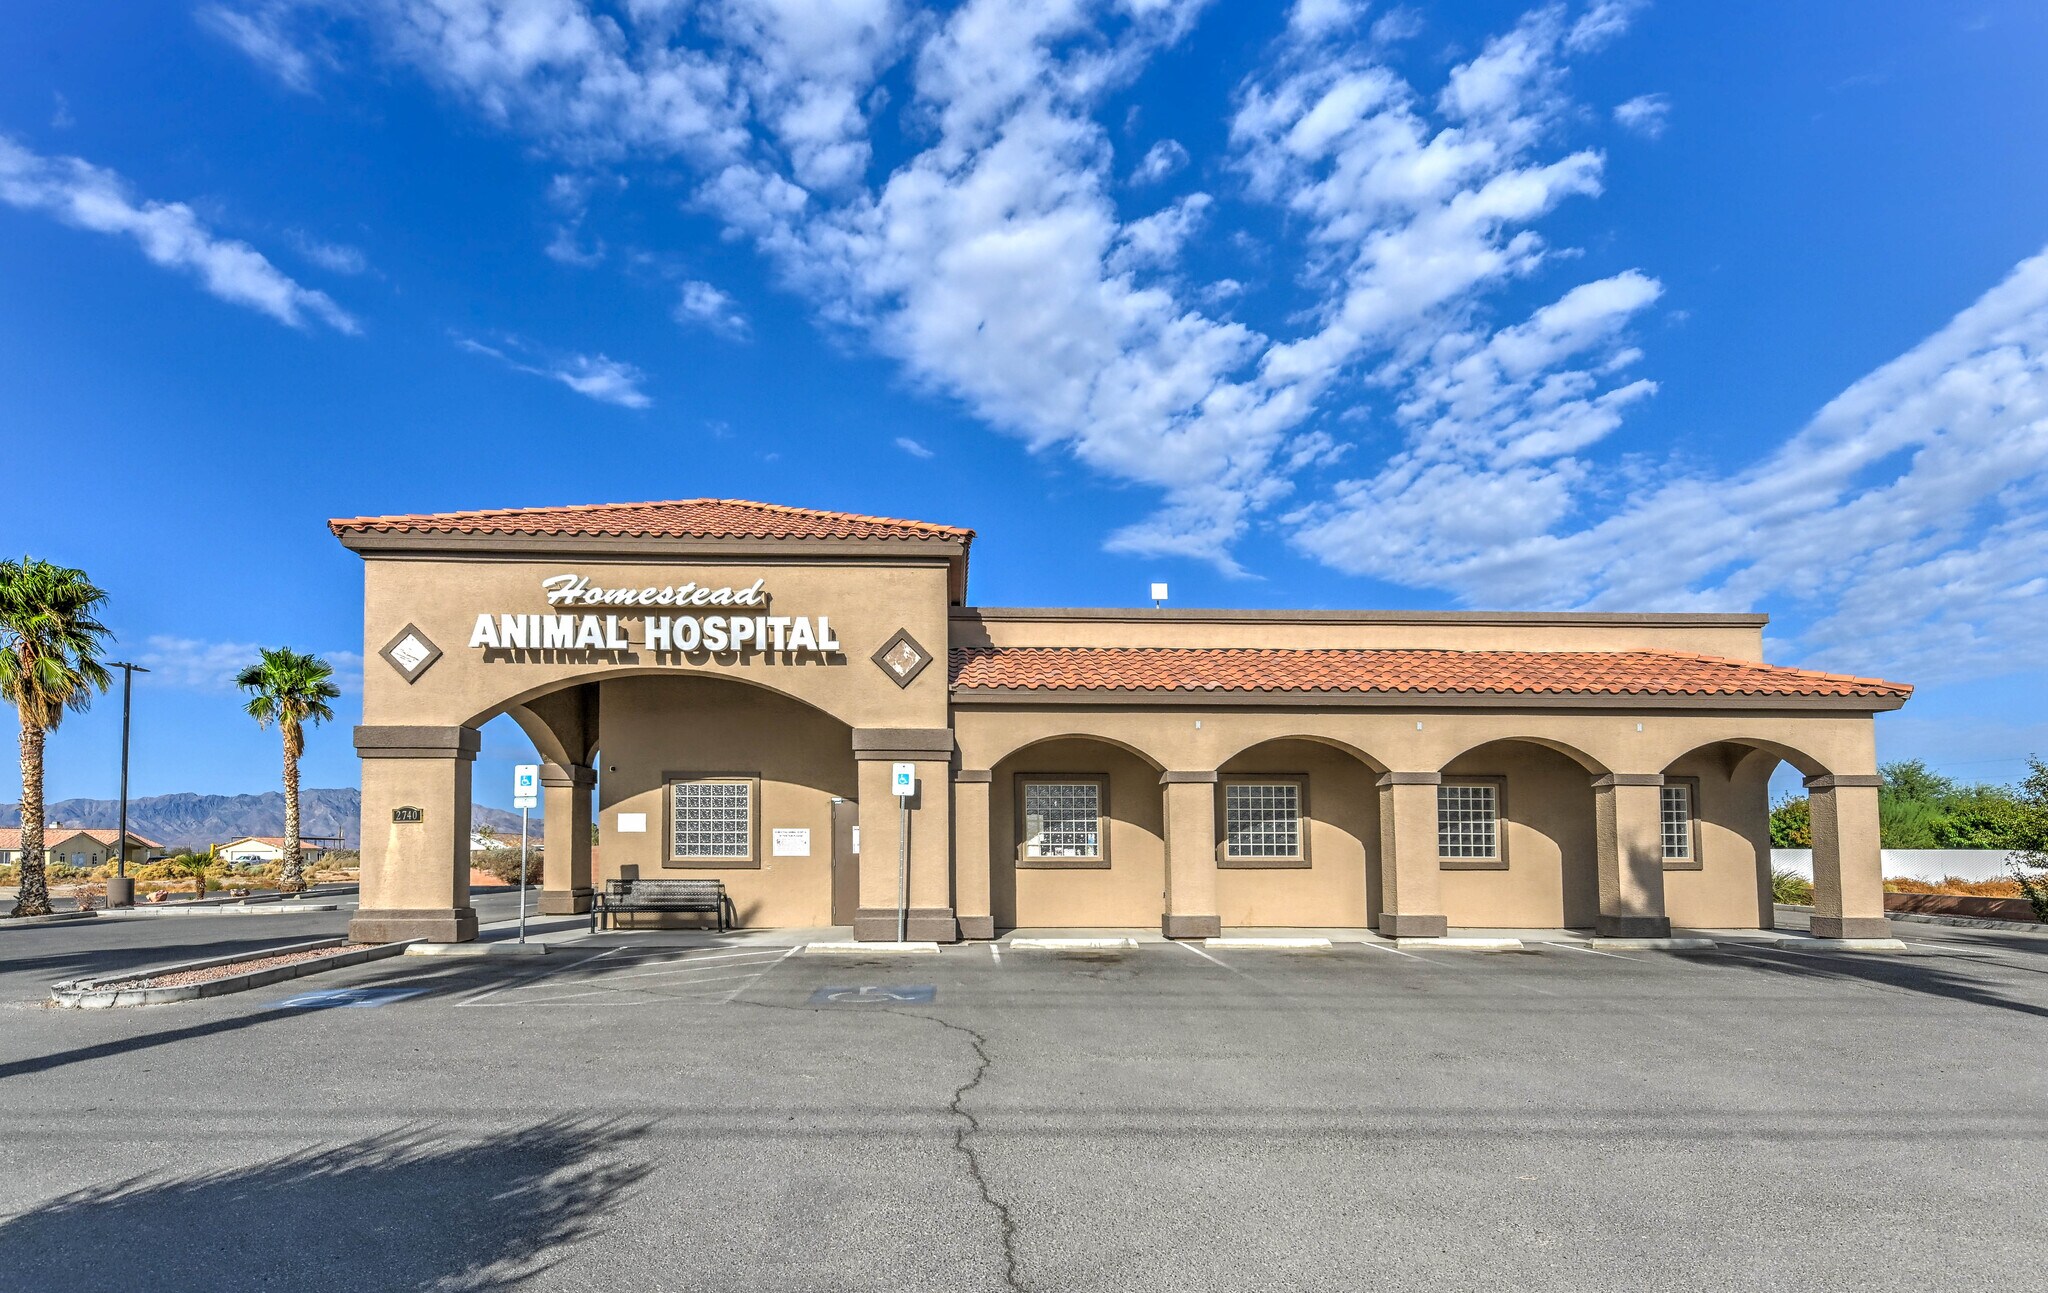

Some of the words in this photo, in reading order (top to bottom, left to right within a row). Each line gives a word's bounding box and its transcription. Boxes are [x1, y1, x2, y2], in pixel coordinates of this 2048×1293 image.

[541, 573, 765, 606] Homestead
[468, 613, 629, 650] ANIMAL
[644, 615, 840, 651] HOSPITAL
[395, 810, 418, 820] 2740
